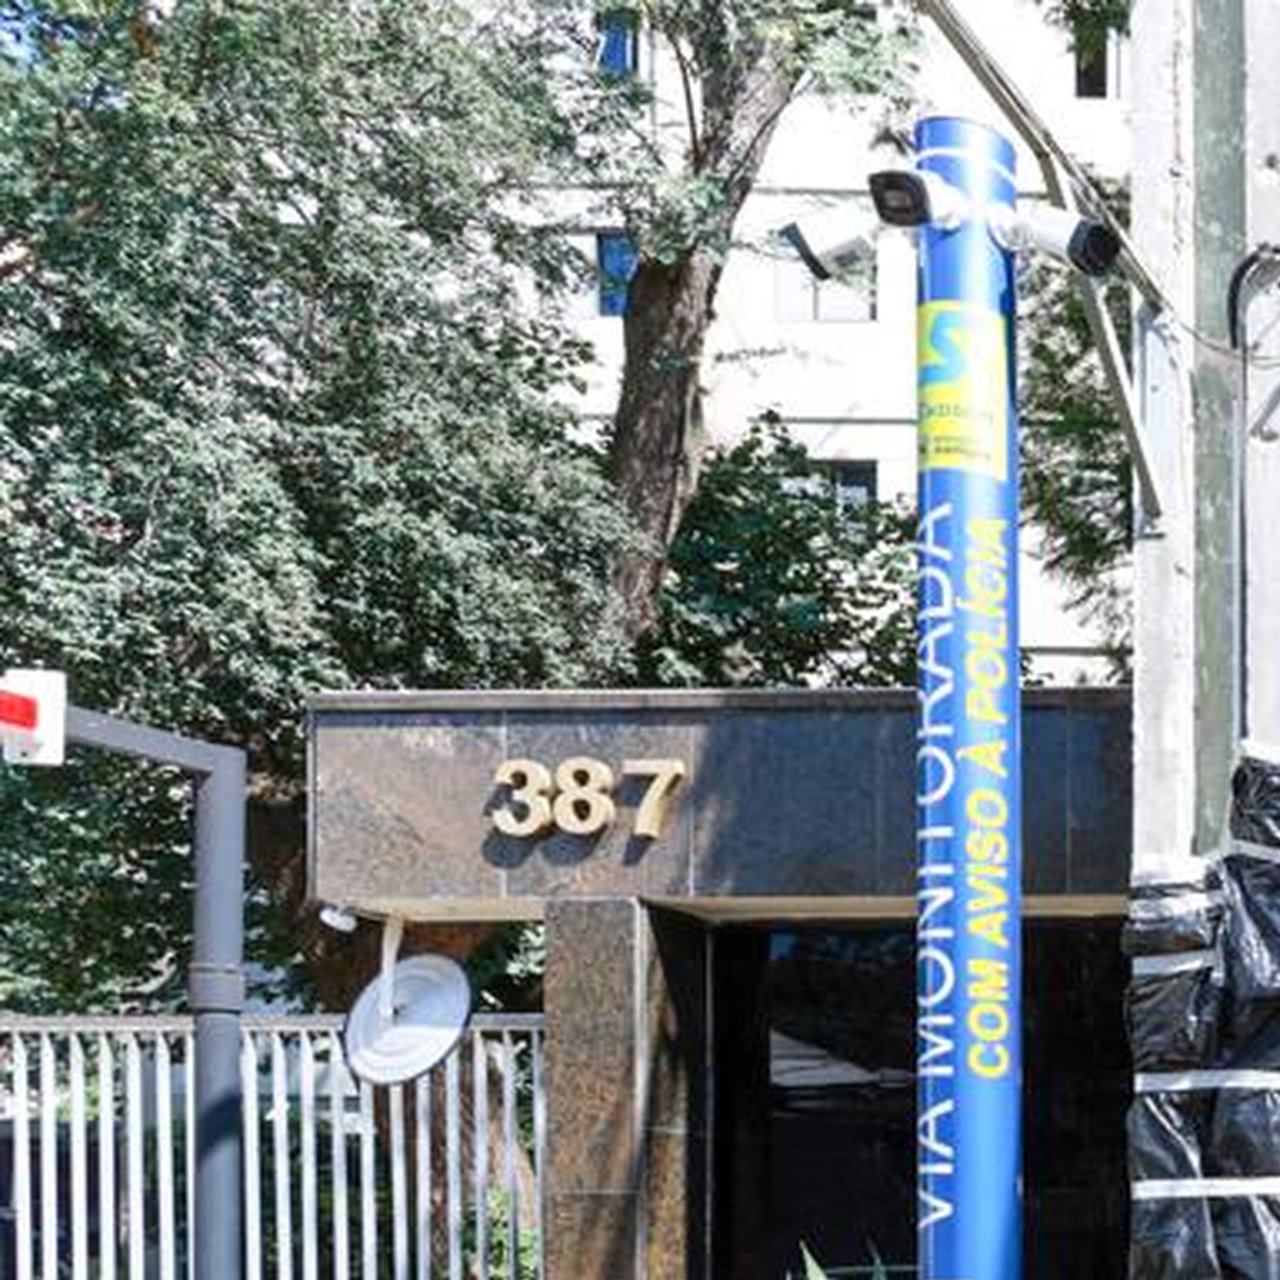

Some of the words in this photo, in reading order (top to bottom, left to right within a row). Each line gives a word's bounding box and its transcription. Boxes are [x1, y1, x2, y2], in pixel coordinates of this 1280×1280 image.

[955, 517, 1009, 725] POLÍCIA
[493, 756, 687, 838] 387
[917, 502, 954, 1078] MONITORADA
[955, 740, 1009, 778] À
[966, 788, 1010, 947] AVISO
[966, 958, 1010, 1080] COM
[917, 1098, 954, 1230] VIA
